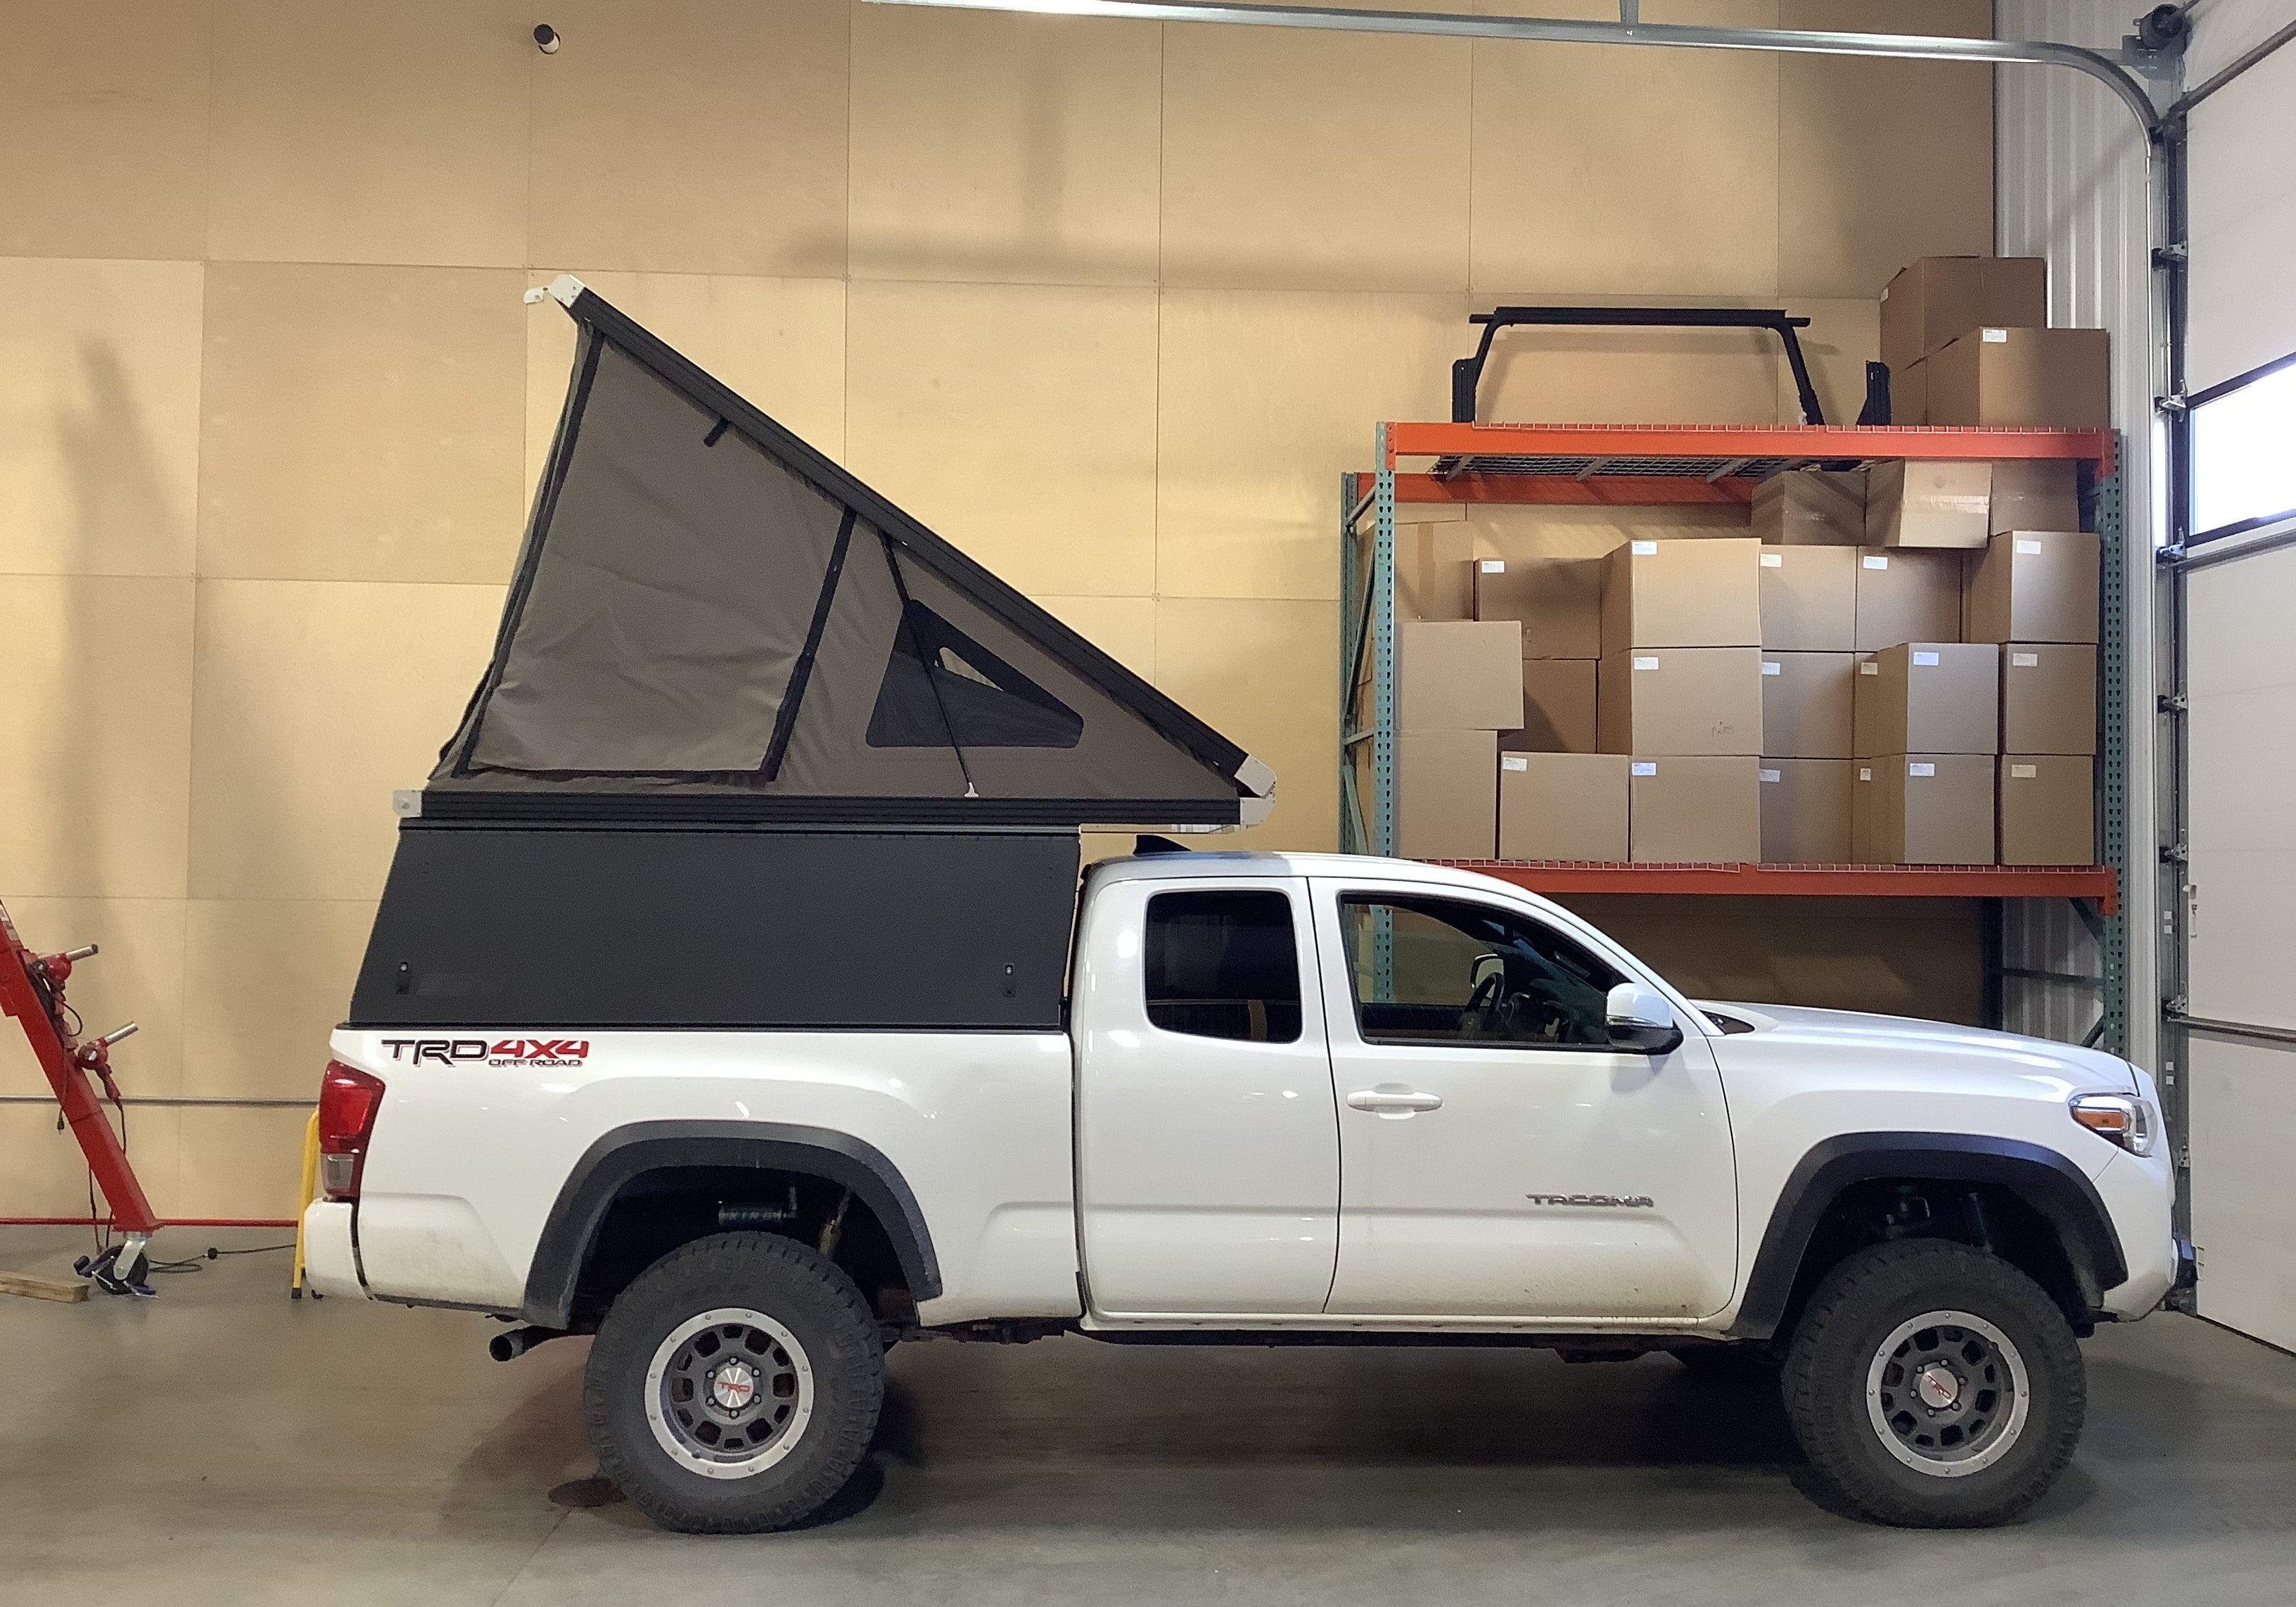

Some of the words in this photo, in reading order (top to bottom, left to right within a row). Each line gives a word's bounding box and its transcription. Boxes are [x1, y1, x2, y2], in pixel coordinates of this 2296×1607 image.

[381, 1039, 489, 1067] TRD
[530, 1059, 582, 1067] ROAD
[1525, 1193, 1654, 1207] TACOMA
[717, 1381, 751, 1394] TRD
